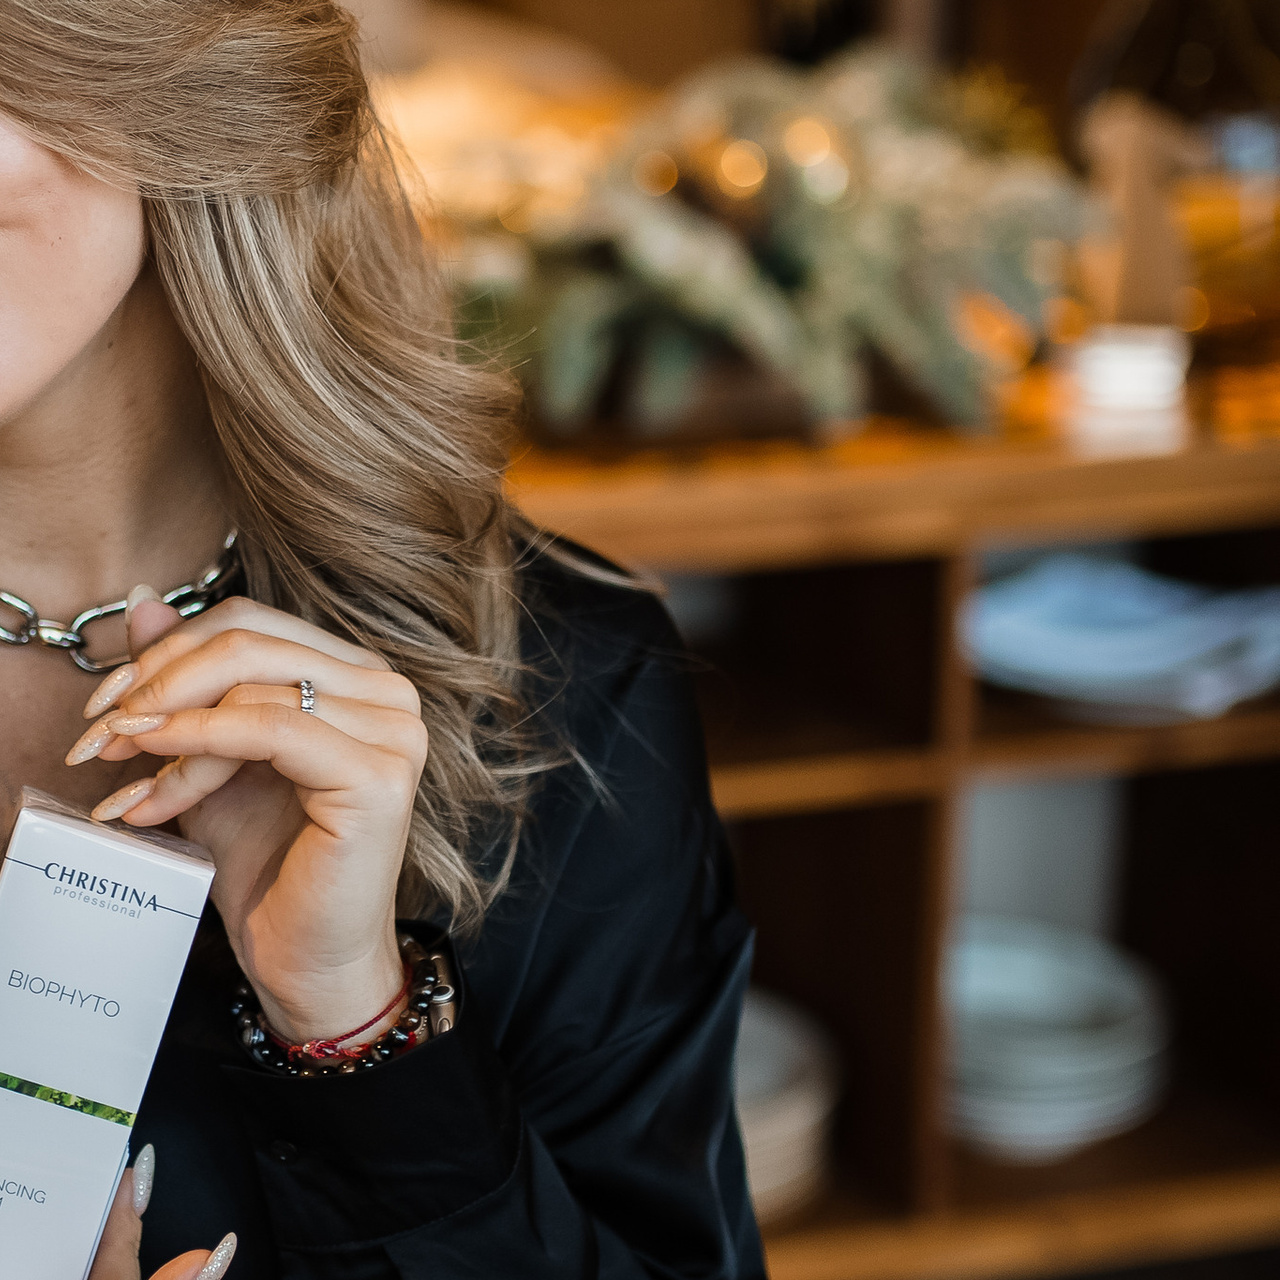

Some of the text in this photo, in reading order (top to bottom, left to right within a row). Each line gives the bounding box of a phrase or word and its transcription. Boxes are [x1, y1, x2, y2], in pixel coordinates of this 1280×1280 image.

[44, 862, 158, 912] CHRISTINA
[53, 885, 141, 919] professional
[7, 969, 120, 1017] BIOPHYTO
